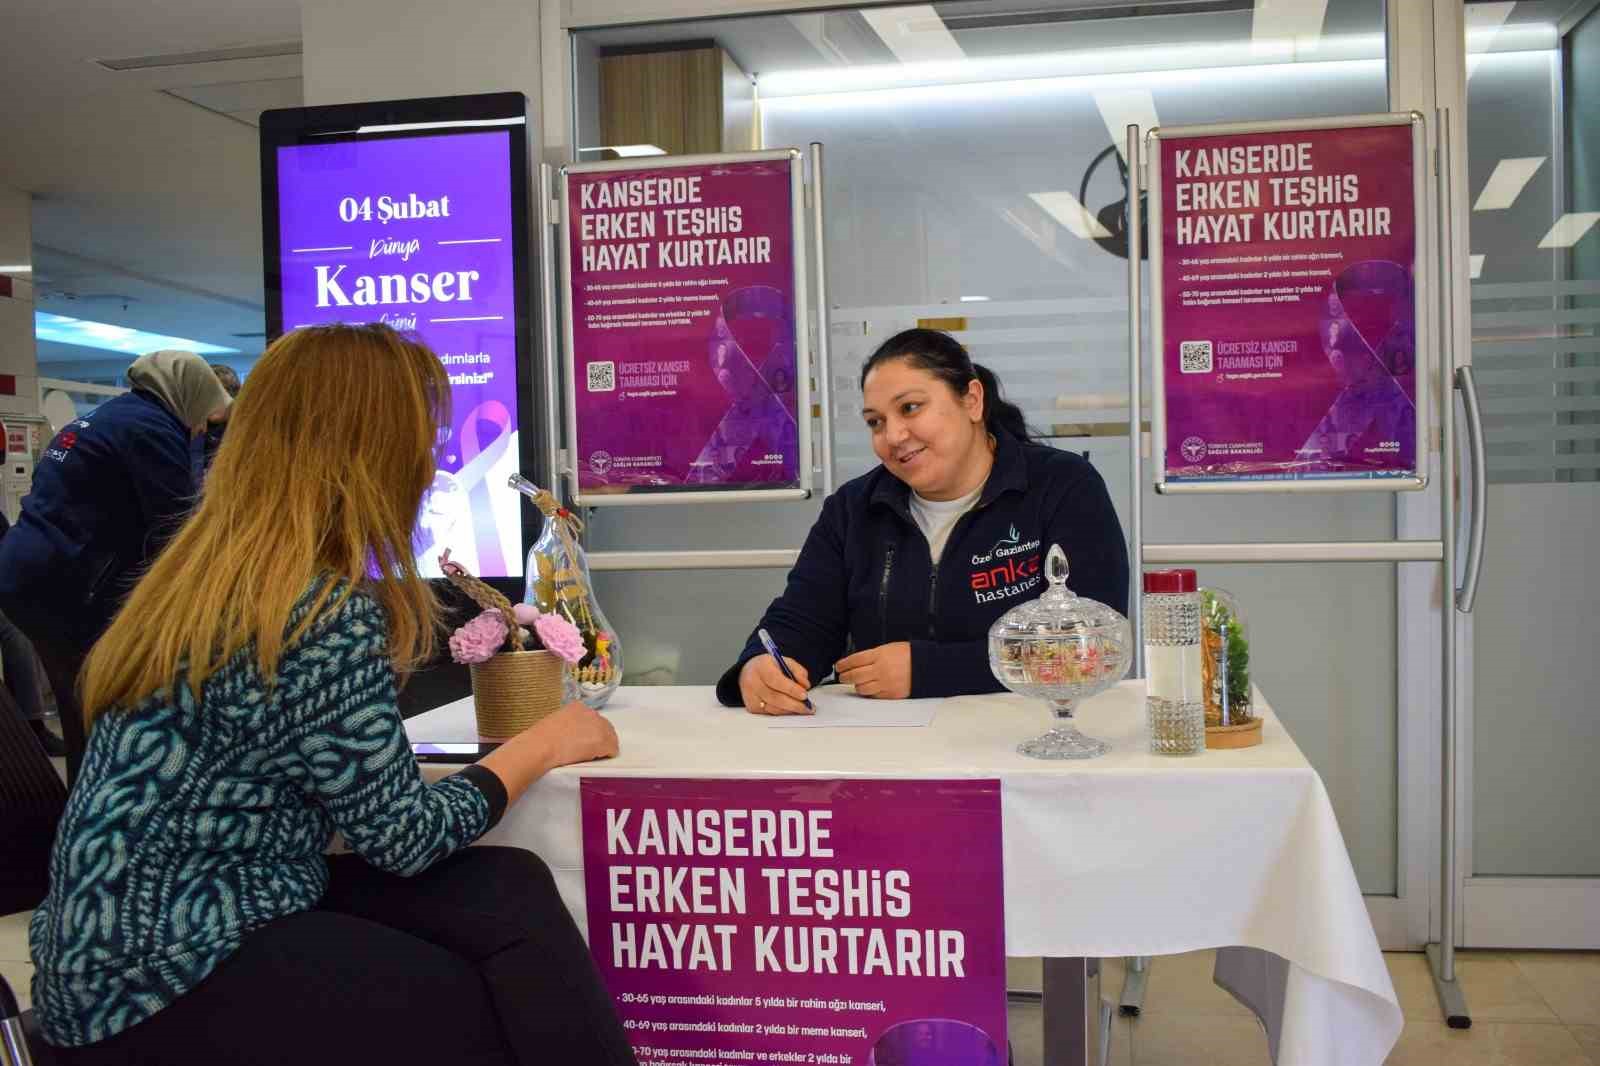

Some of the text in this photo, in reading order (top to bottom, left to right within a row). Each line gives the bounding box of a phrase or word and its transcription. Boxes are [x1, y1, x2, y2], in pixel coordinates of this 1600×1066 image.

[1175, 143, 1313, 178] KANSERDE
[580, 176, 702, 209] KANSERDE
[1176, 179, 1260, 212] ERKEN
[339, 193, 451, 225] 04 Şubat
[581, 210, 656, 241] ERKEN
[1177, 207, 1391, 245] HAYAT KURTARIR
[368, 237, 421, 262] Dünya
[582, 236, 771, 272] HAYAT KURTARIR
[313, 264, 480, 308] Kanser
[438, 352, 491, 365] dımlarla
[1262, 340, 1297, 353] KANSER
[995, 540, 1041, 558] Gaziantep
[606, 808, 834, 858] KANSERDE
[608, 866, 747, 915] ERKEN
[611, 923, 966, 978] HAYAT KURTARIR
[622, 993, 887, 1013] 30-65 yaş arasındaki kadınlar 5 yılda bir rahim ağzı kanseri,
[624, 1020, 868, 1039] 40-69 yaş arasındaki kadınlar 2 yılda bir meme kanseri,
[652, 1048, 669, 1058] yaş
[669, 1048, 717, 1059] arasındaki
[718, 1048, 754, 1060] kadınlar
[756, 1051, 767, 1061] ve
[769, 1051, 806, 1062] erkekler
[807, 1053, 815, 1063] 2
[816, 1053, 838, 1065] yılda
[840, 1053, 852, 1064] bir
